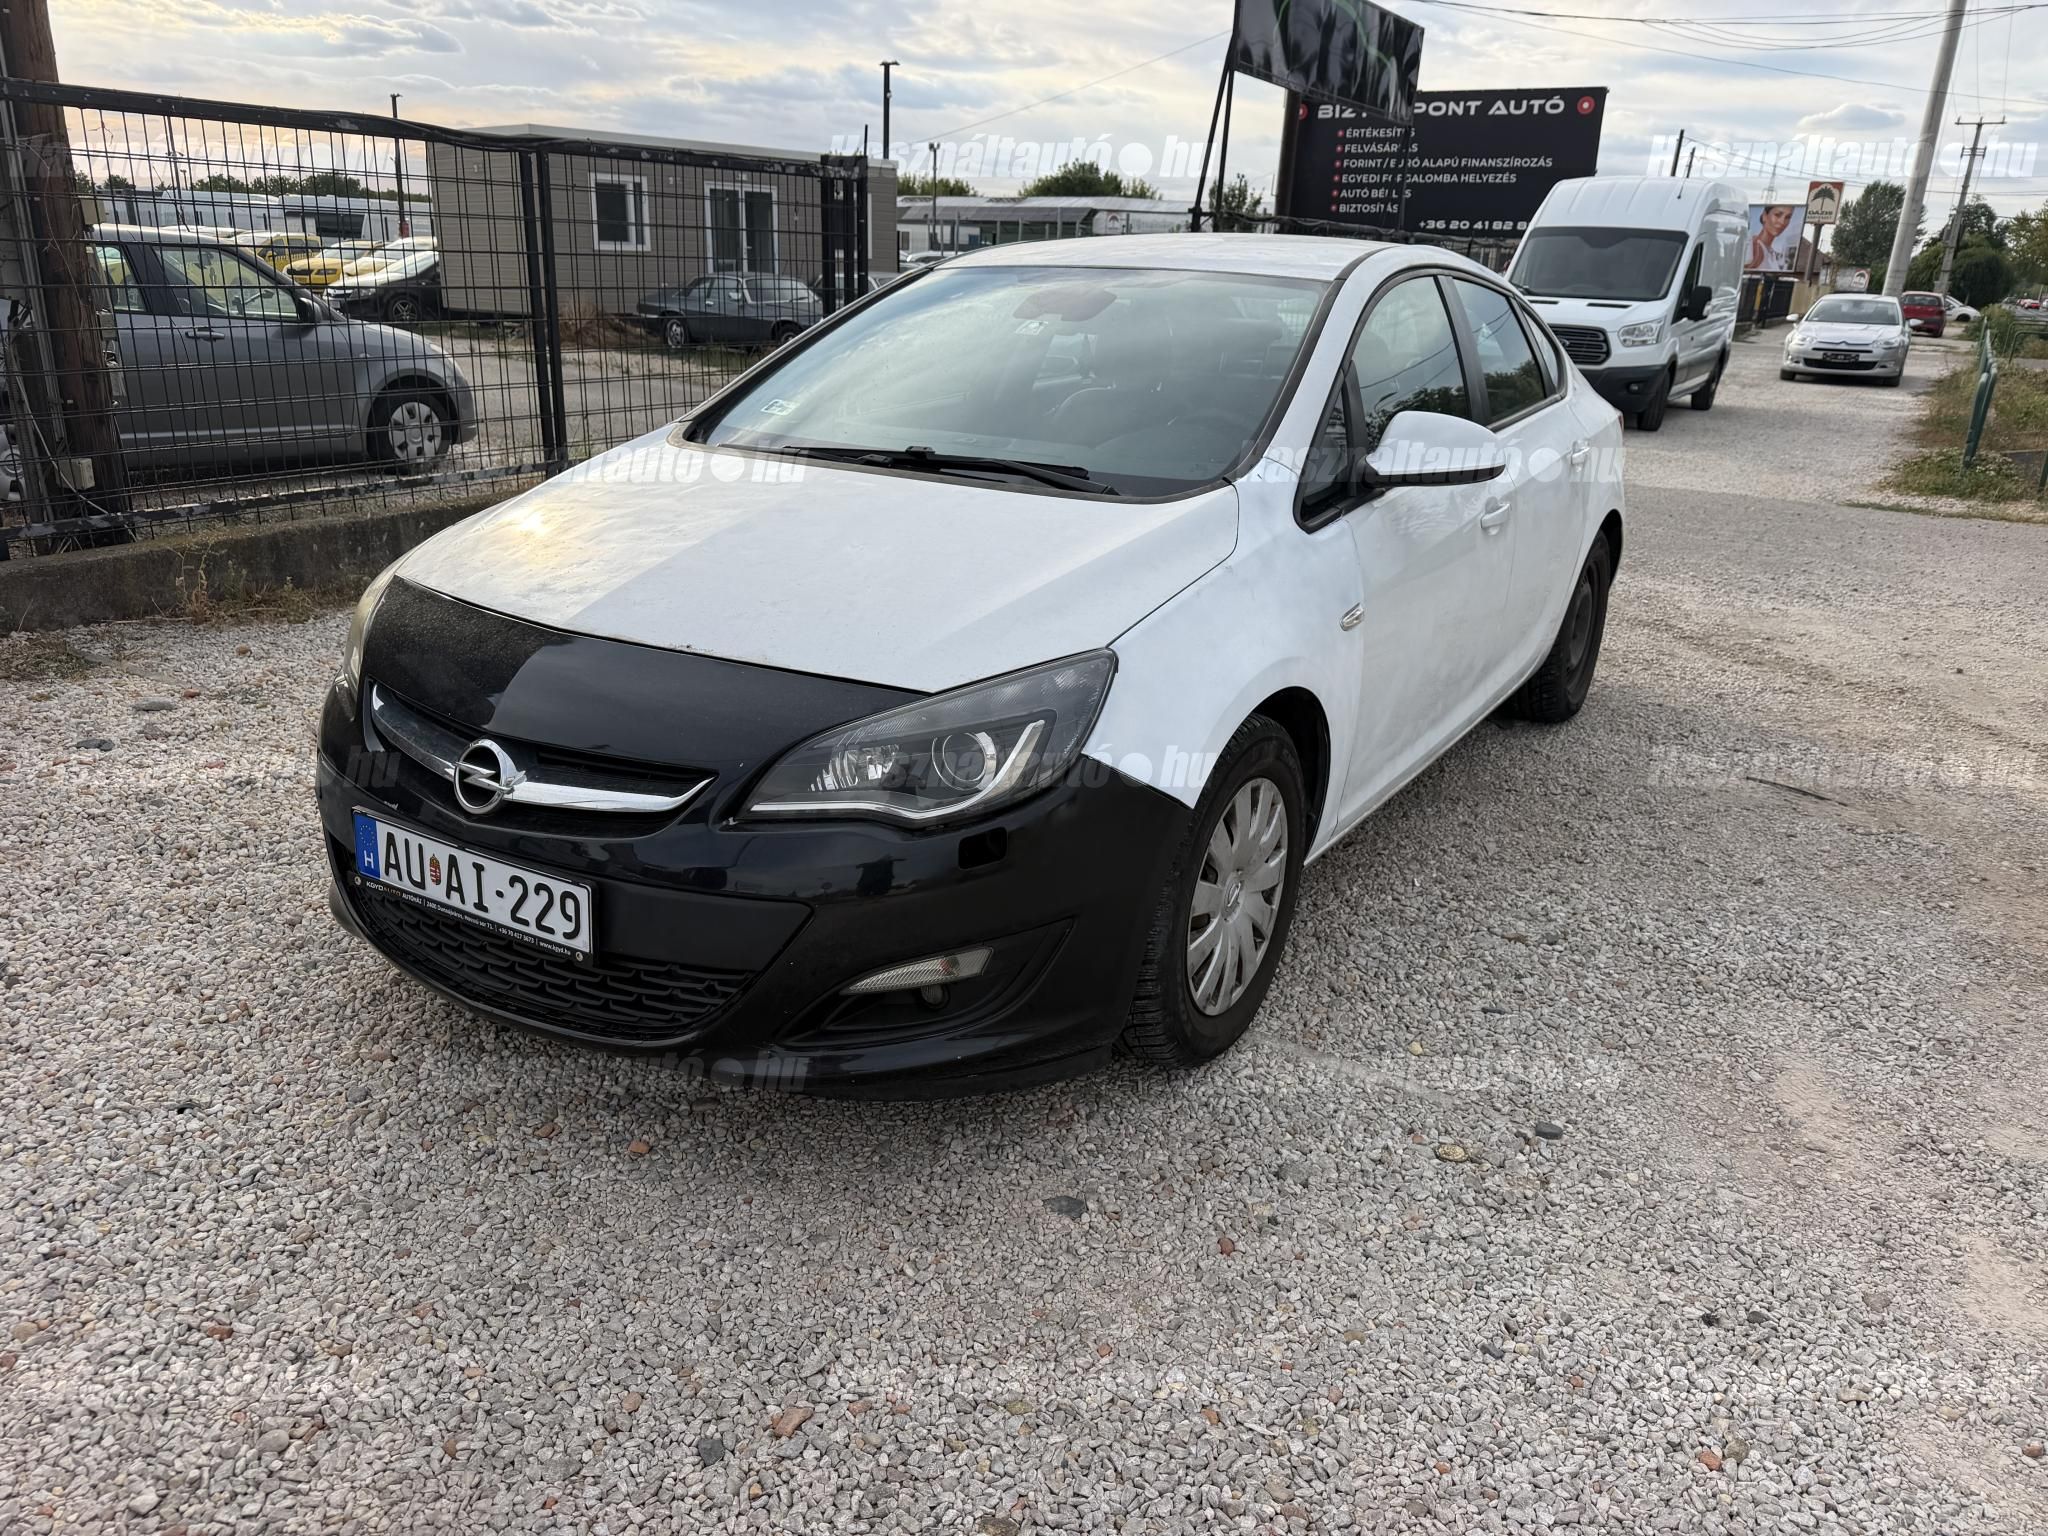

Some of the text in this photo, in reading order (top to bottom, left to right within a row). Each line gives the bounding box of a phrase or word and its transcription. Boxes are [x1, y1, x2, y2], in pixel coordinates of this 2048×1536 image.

[1414, 100, 1482, 116] PONT
[1488, 95, 1565, 115] AUTÓ
[1345, 126, 1416, 138] ÉRTÉKESÍTS
[1344, 142, 1418, 153] FELVÁSÁRS
[1422, 156, 1459, 168] ALAPÚ
[1461, 155, 1553, 168] FINANSZÍROZÁS
[1341, 173, 1380, 184] EGYEDI
[1460, 172, 1517, 183] HELYEZÉS
[1340, 186, 1369, 198] AUTÓ
[1419, 219, 1447, 230] +36
[1449, 220, 1470, 230] 20
[1492, 221, 1514, 230] 82
[1516, 221, 1530, 231] 8
[363, 850, 375, 870] H
[384, 831, 581, 940] AU AI-229
